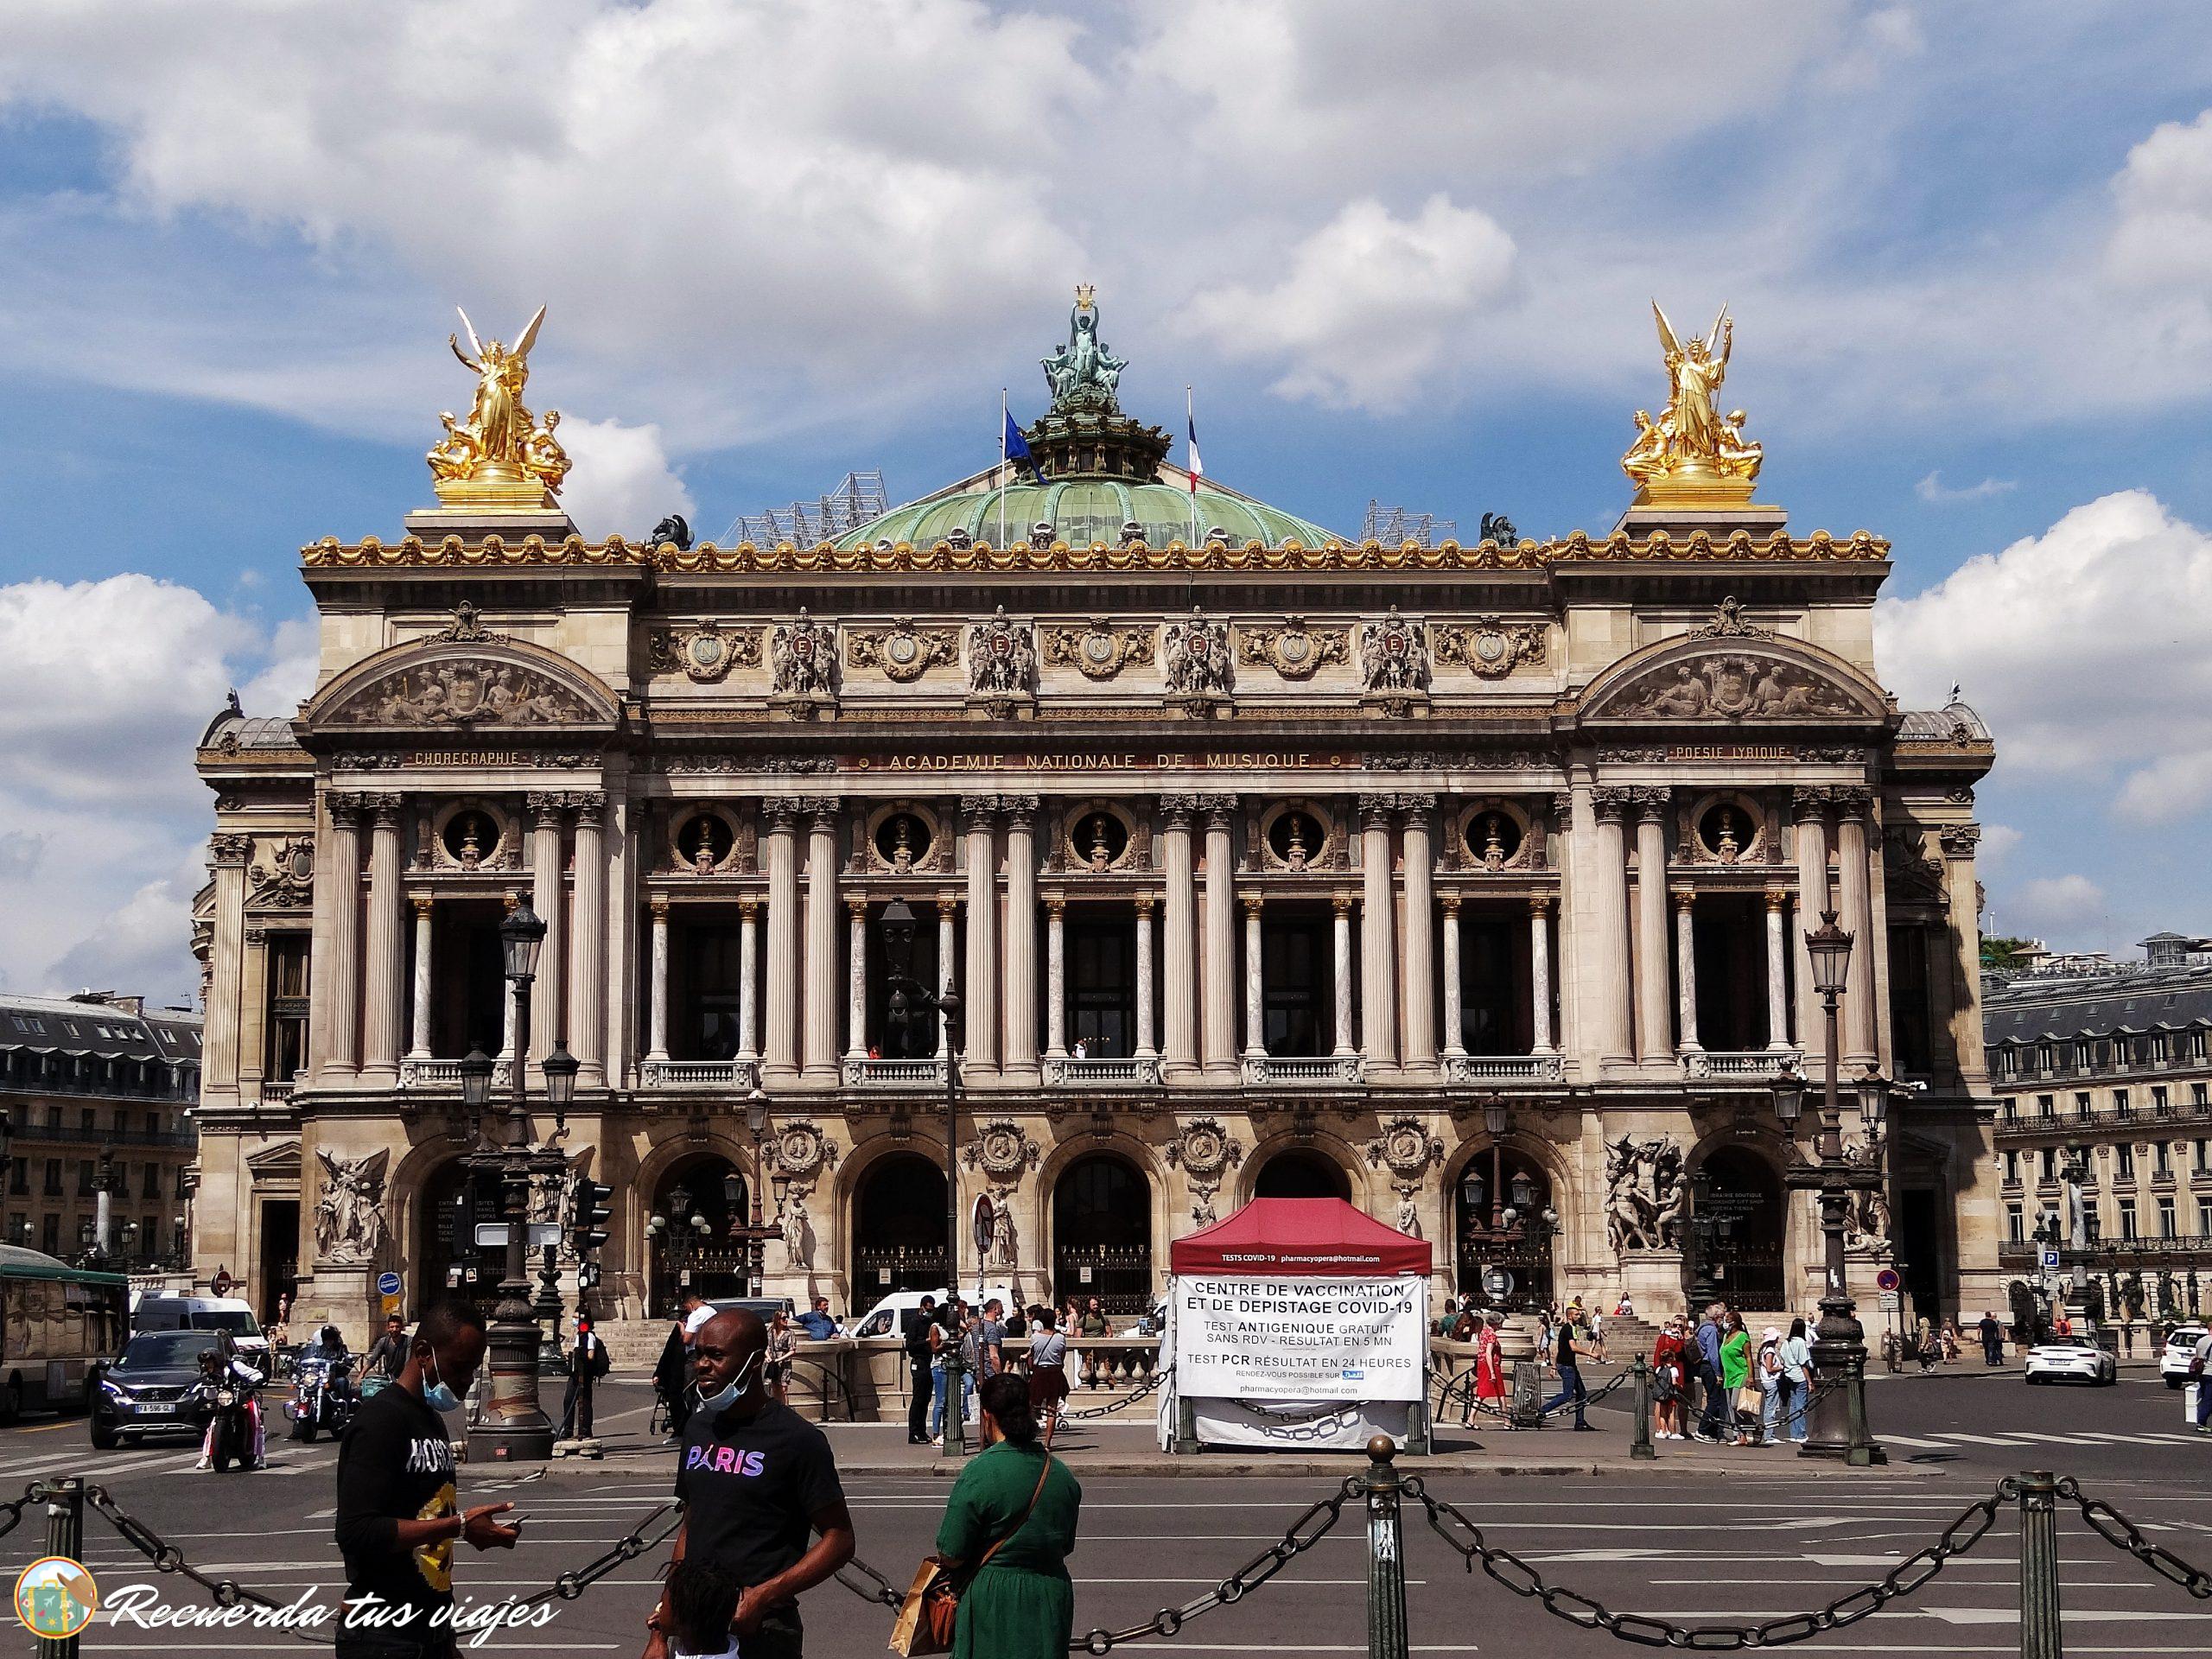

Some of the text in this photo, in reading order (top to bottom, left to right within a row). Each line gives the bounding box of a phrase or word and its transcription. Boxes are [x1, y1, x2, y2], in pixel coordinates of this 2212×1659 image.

[798, 639, 807, 652] E
[995, 639, 1004, 652] E
[1193, 639, 1202, 652] E
[1389, 639, 1399, 652] E
[415, 752, 519, 766] CHOREGRAPHIE
[1676, 747, 1787, 760] POESIE LYRIQUE
[889, 753, 1311, 770] ACADEMIE NATIONALE DE MUSIQUE
[1281, 1255, 1380, 1263] pharmacyopera@hotmail.com
[2047, 1254, 2055, 1264] P
[1195, 1282, 1404, 1297] CENTRE DE VACCINATION
[1187, 1297, 1413, 1314] ET DE DEPISTAGE COVID-19
[1204, 1321, 1234, 1332] TEST
[1237, 1322, 1334, 1334] ANTIGENIQUE
[1206, 1333, 1238, 1344] SANS
[1243, 1335, 1268, 1344] RDV
[1344, 1337, 1359, 1346] EN
[1363, 1337, 1370, 1346] 5
[1374, 1337, 1392, 1346] MN
[1187, 1354, 1411, 1368] TEST PCR RÉSULTAT EN 24 HEURES
[1240, 1385, 1358, 1395] pharmacyopera@hotmailcom
